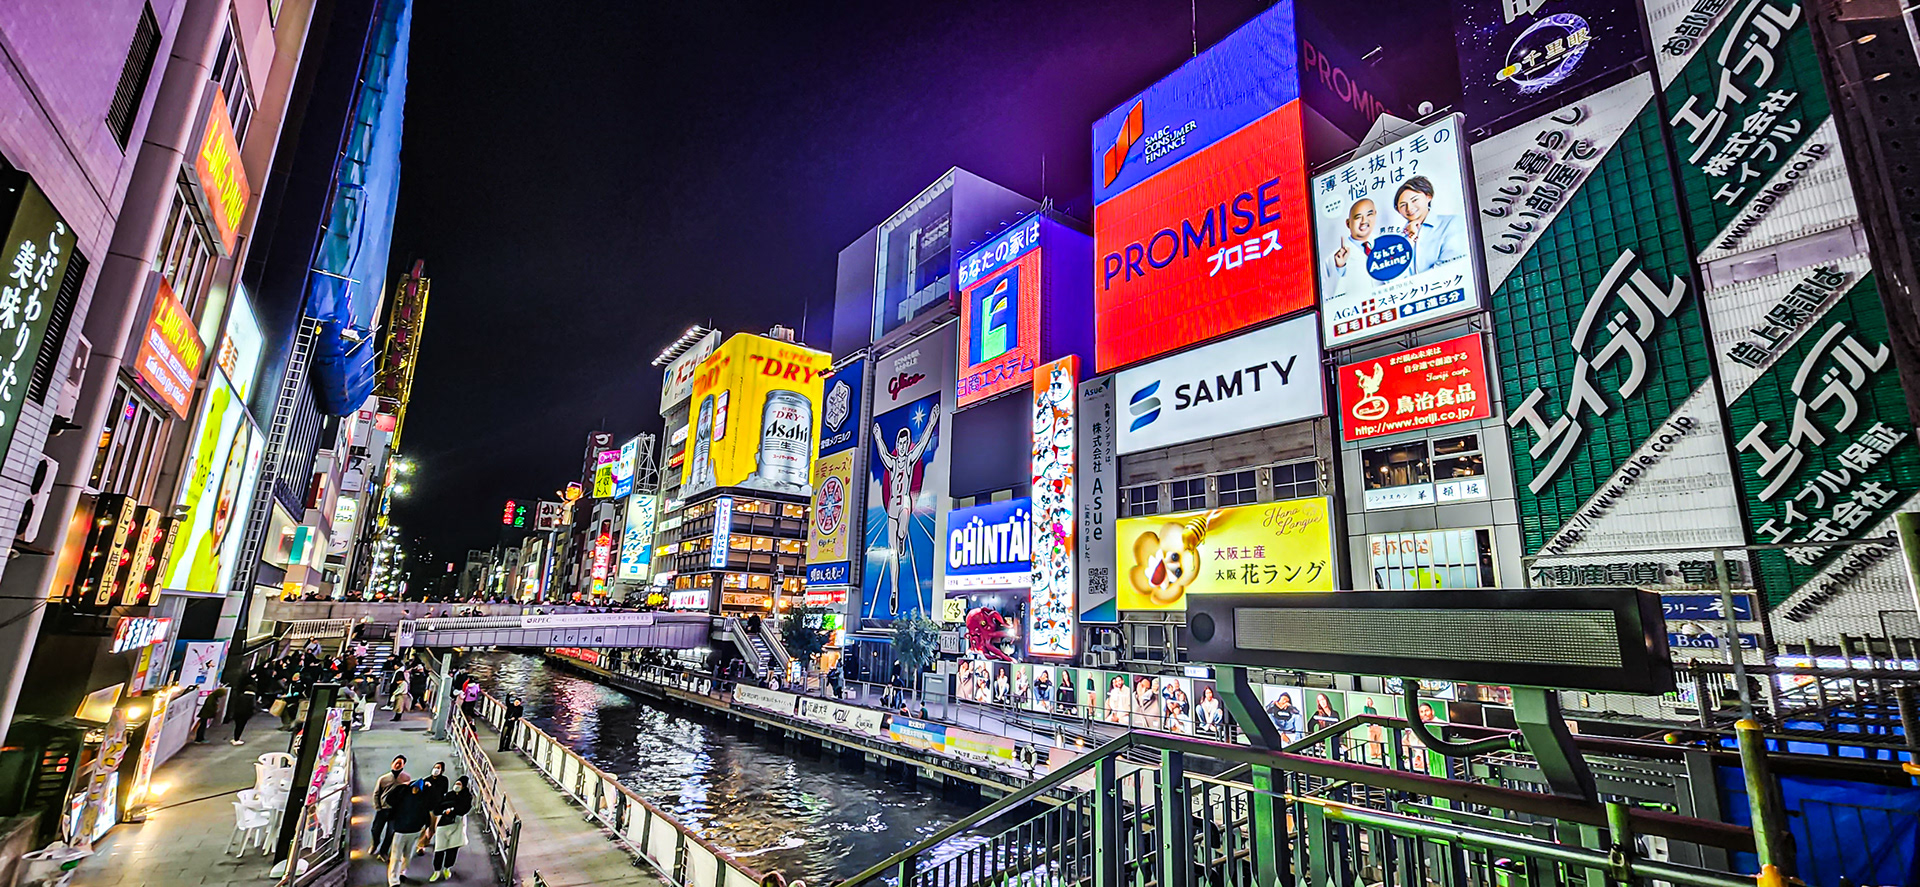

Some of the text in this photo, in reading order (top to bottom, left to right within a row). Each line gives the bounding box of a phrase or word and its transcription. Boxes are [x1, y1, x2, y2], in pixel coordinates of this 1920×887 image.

[1522, 27, 1592, 67] 千里眼
[1670, 3, 1801, 143] エイブル
[1144, 125, 1170, 146] SMBC
[1144, 120, 1198, 154] CONSUMER
[1145, 136, 1186, 164] FINANCE
[1702, 89, 1798, 176] 株式会社
[202, 118, 245, 233] LONG DINH
[1482, 106, 1585, 218] いい暮らし
[1713, 119, 1801, 206] エイブル
[1492, 139, 1598, 255] いい部屋で
[1717, 142, 1827, 251] www.able.co.jp
[958, 221, 1040, 283] あなたの家は
[1104, 176, 1282, 291] PROMISE
[1207, 230, 1283, 277] プロミス
[1369, 252, 1411, 273] Asking!
[1333, 275, 1463, 321] AGA スキンクリニック
[1725, 266, 1848, 369] 借上保証は
[155, 297, 201, 371] LONG DINH
[778, 349, 812, 363] SUPER
[888, 373, 926, 401] Glico
[957, 354, 1034, 398] 日商エステム
[1175, 354, 1298, 411] SAMTY
[1507, 268, 1687, 460] エイブル
[1084, 385, 1104, 397] Asue
[1396, 383, 1477, 414] 鳥治食品
[1735, 335, 1890, 478] エイブル
[766, 420, 808, 443] Asahi
[1355, 405, 1476, 436] http://www.toriji.co.jp/
[780, 441, 792, 449] 生
[896, 471, 904, 506] グリコ
[1091, 422, 1104, 541] 株式会社 Asue
[1547, 413, 1694, 556] http://www.able.co.jp
[1757, 420, 1910, 545] エイブル保証
[1263, 506, 1300, 528] Hana
[1276, 515, 1322, 536] Langue
[949, 517, 1030, 570] CHINTAI
[1214, 545, 1266, 561] 大阪土産
[1215, 561, 1326, 585] 大阪 花ラング
